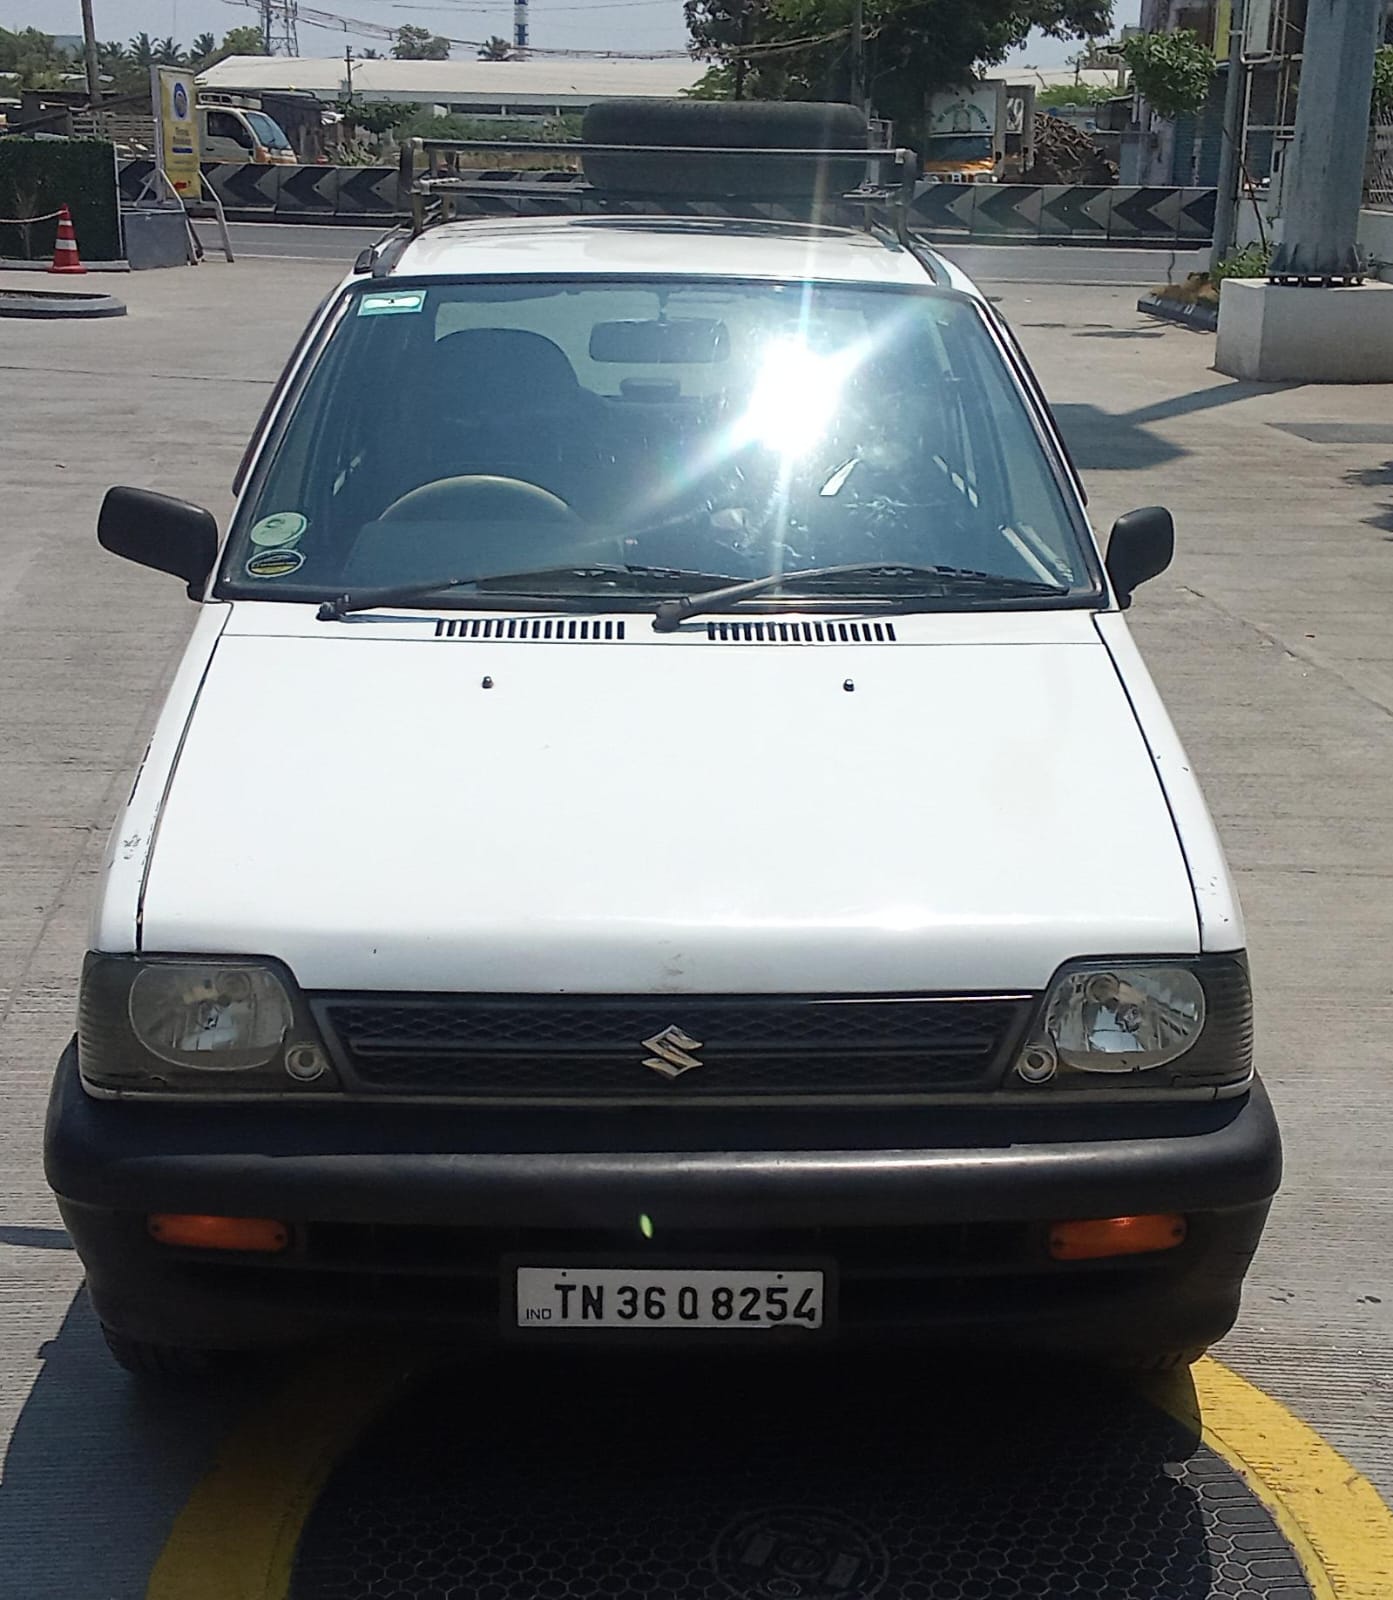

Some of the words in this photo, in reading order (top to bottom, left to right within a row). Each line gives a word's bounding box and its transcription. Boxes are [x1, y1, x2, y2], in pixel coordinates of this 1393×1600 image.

[526, 1308, 552, 1320] IND
[554, 1284, 604, 1319] TN
[616, 1286, 666, 1320] 36
[677, 1286, 698, 1320] Q
[711, 1287, 816, 1321] 8254
